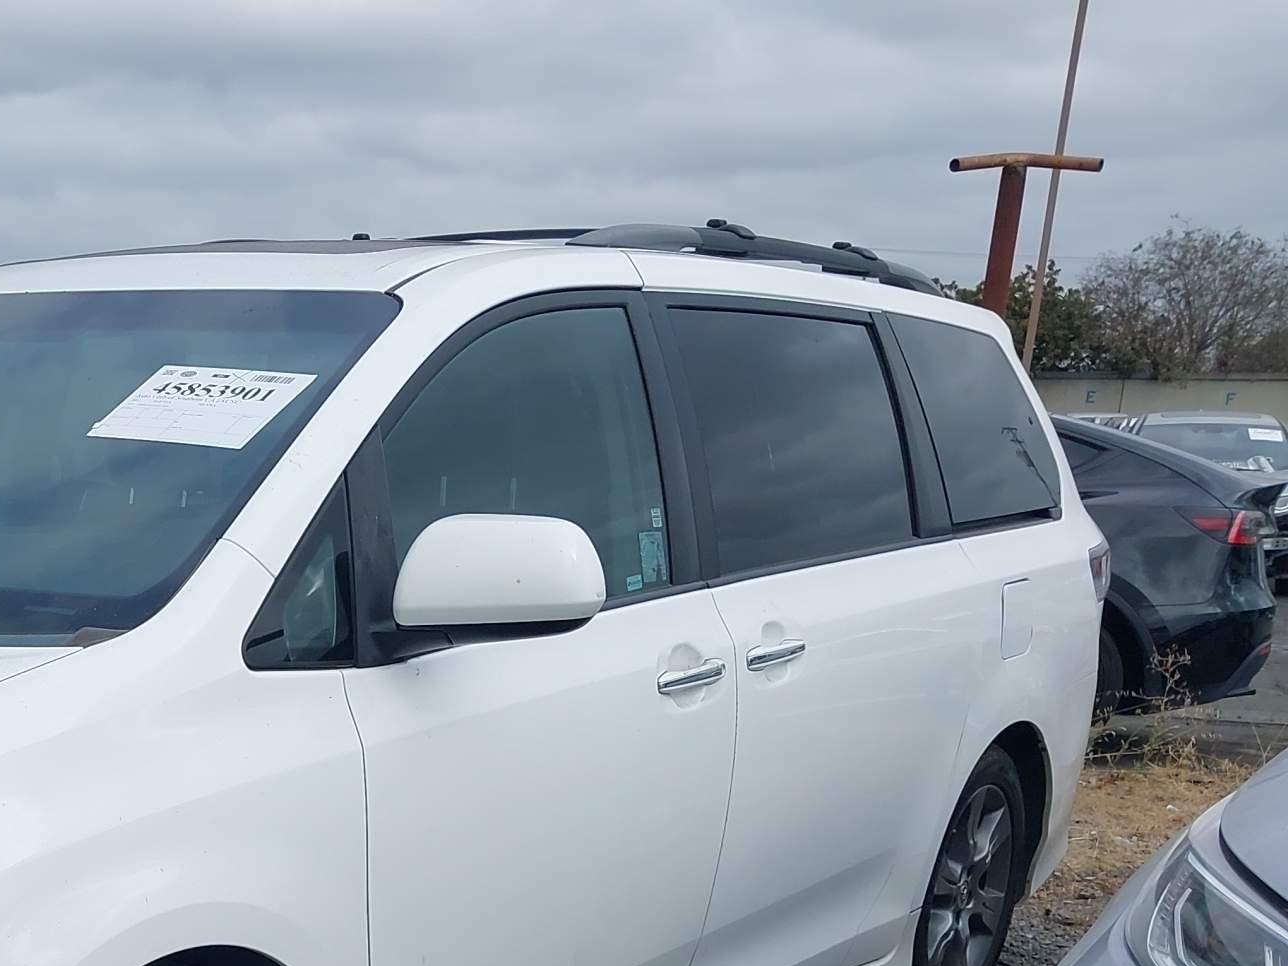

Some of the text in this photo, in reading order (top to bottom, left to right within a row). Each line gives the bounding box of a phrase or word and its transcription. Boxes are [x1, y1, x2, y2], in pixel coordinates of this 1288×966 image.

[152, 381, 276, 402] 45853901
[1085, 390, 1097, 404] E
[1224, 391, 1237, 406] F
